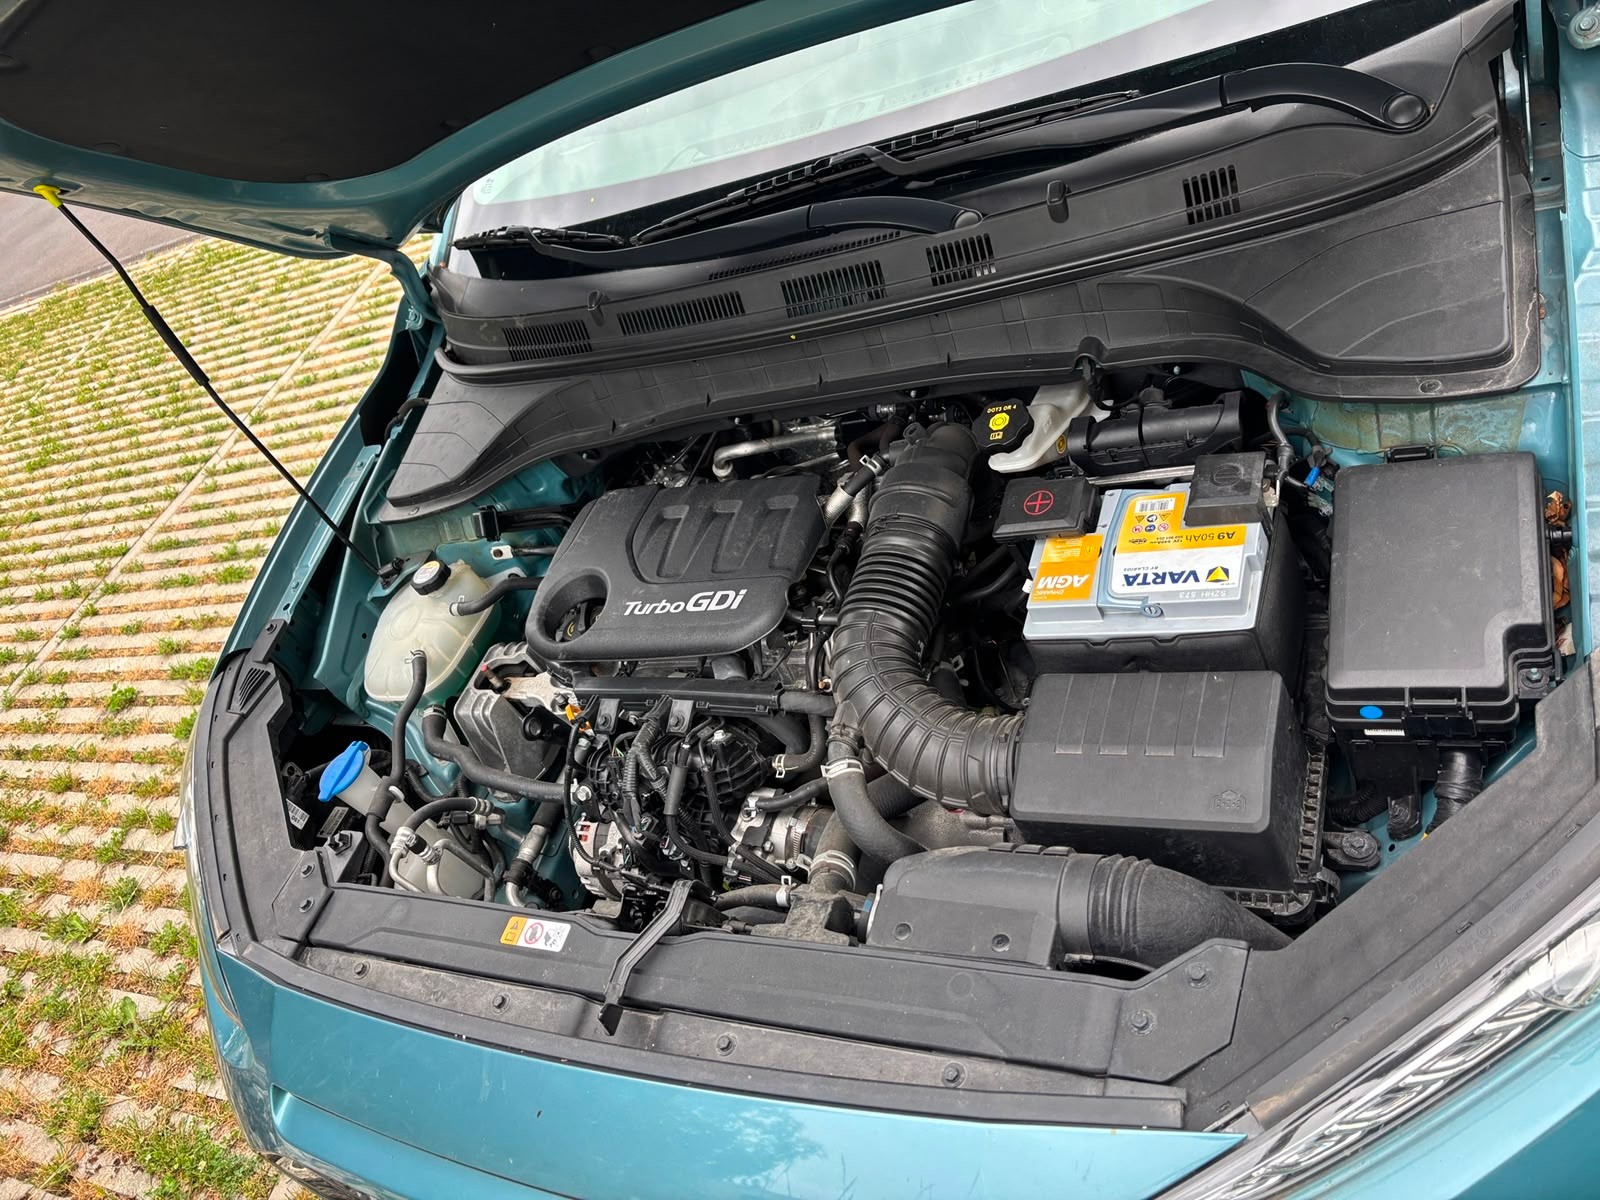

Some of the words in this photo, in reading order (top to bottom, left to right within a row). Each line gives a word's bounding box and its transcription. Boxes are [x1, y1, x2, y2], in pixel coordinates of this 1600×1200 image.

[1185, 533, 1215, 542] 50Ah
[1217, 531, 1236, 541] A9
[1036, 573, 1090, 589] AGM
[1123, 570, 1200, 587] VARTA
